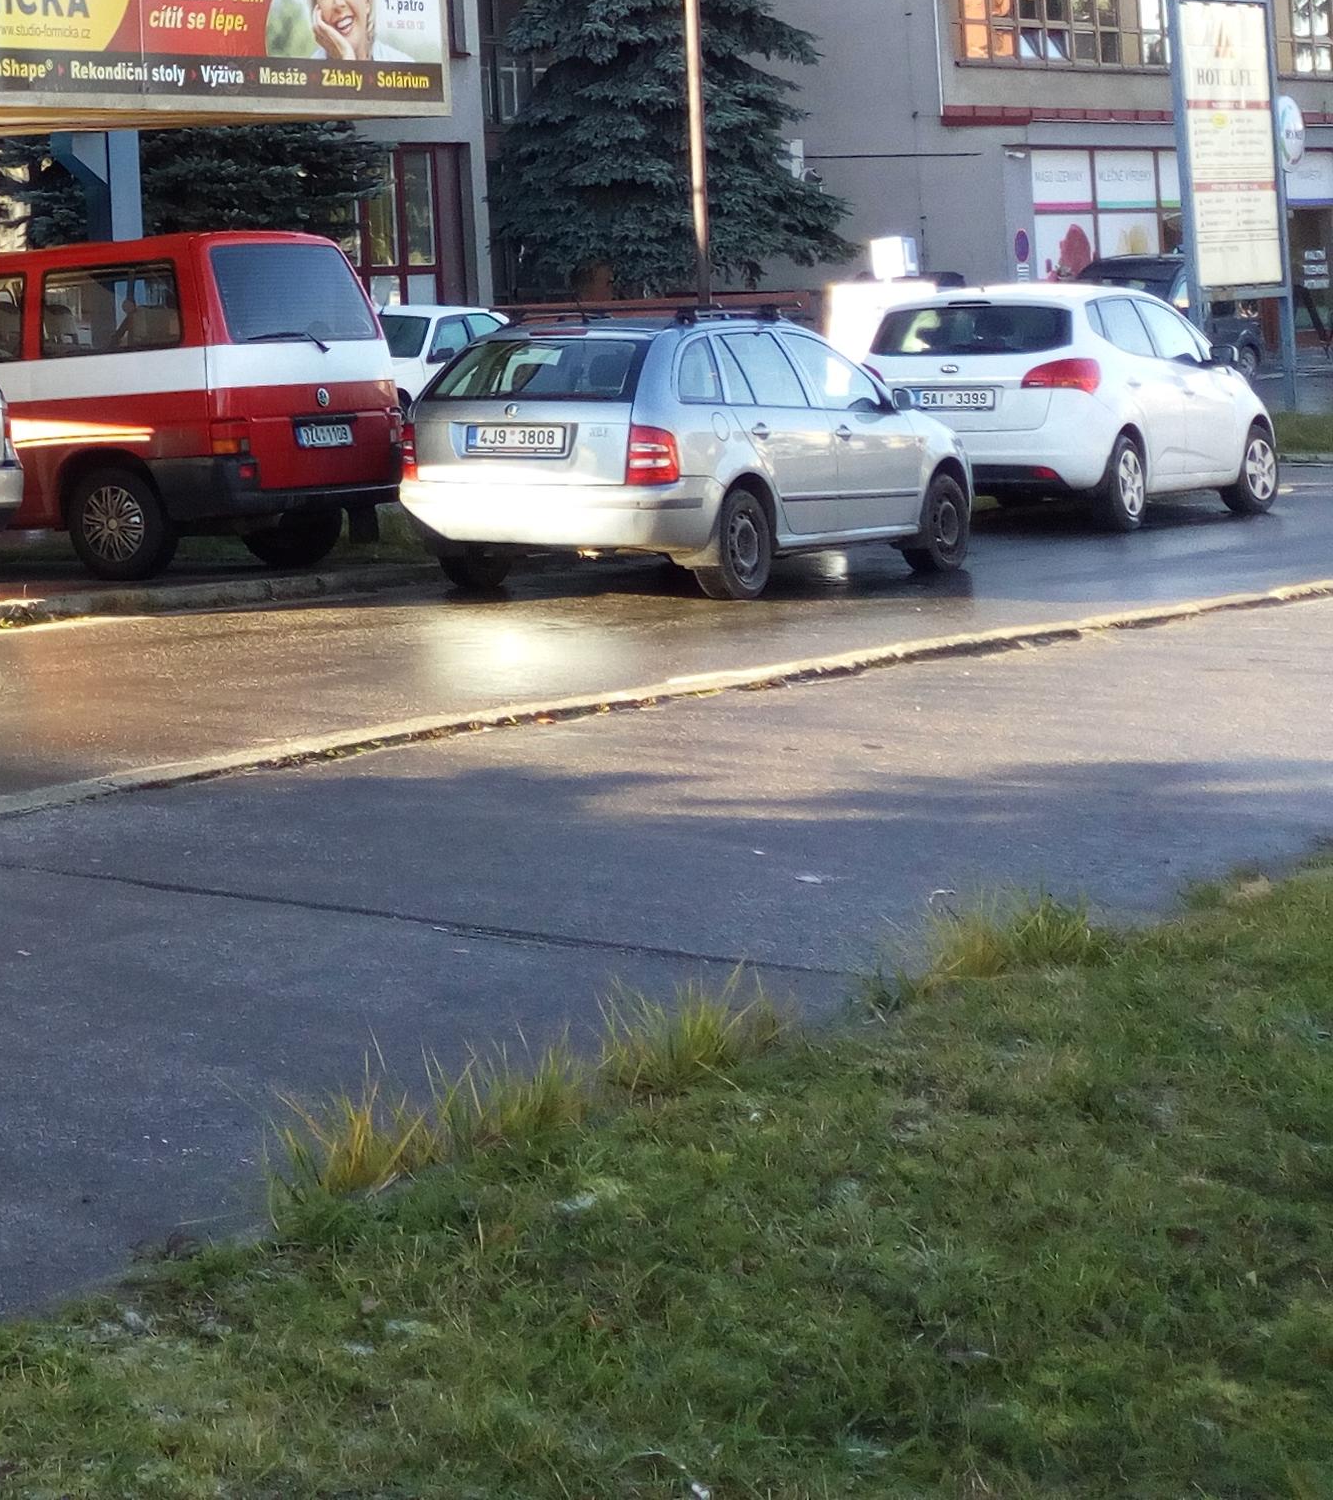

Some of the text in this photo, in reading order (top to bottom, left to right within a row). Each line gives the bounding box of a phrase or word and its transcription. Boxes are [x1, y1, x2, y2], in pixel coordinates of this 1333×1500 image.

[149, 5, 248, 37] cítit se lépe.
[70, 60, 148, 83] Rekondiční
[151, 63, 186, 86] stoly
[200, 63, 245, 87] Výživa
[259, 66, 308, 87] Masáže
[321, 67, 364, 90] Zábaly
[376, 69, 430, 90] Solárium
[480, 429, 555, 446] 4J9 3808
